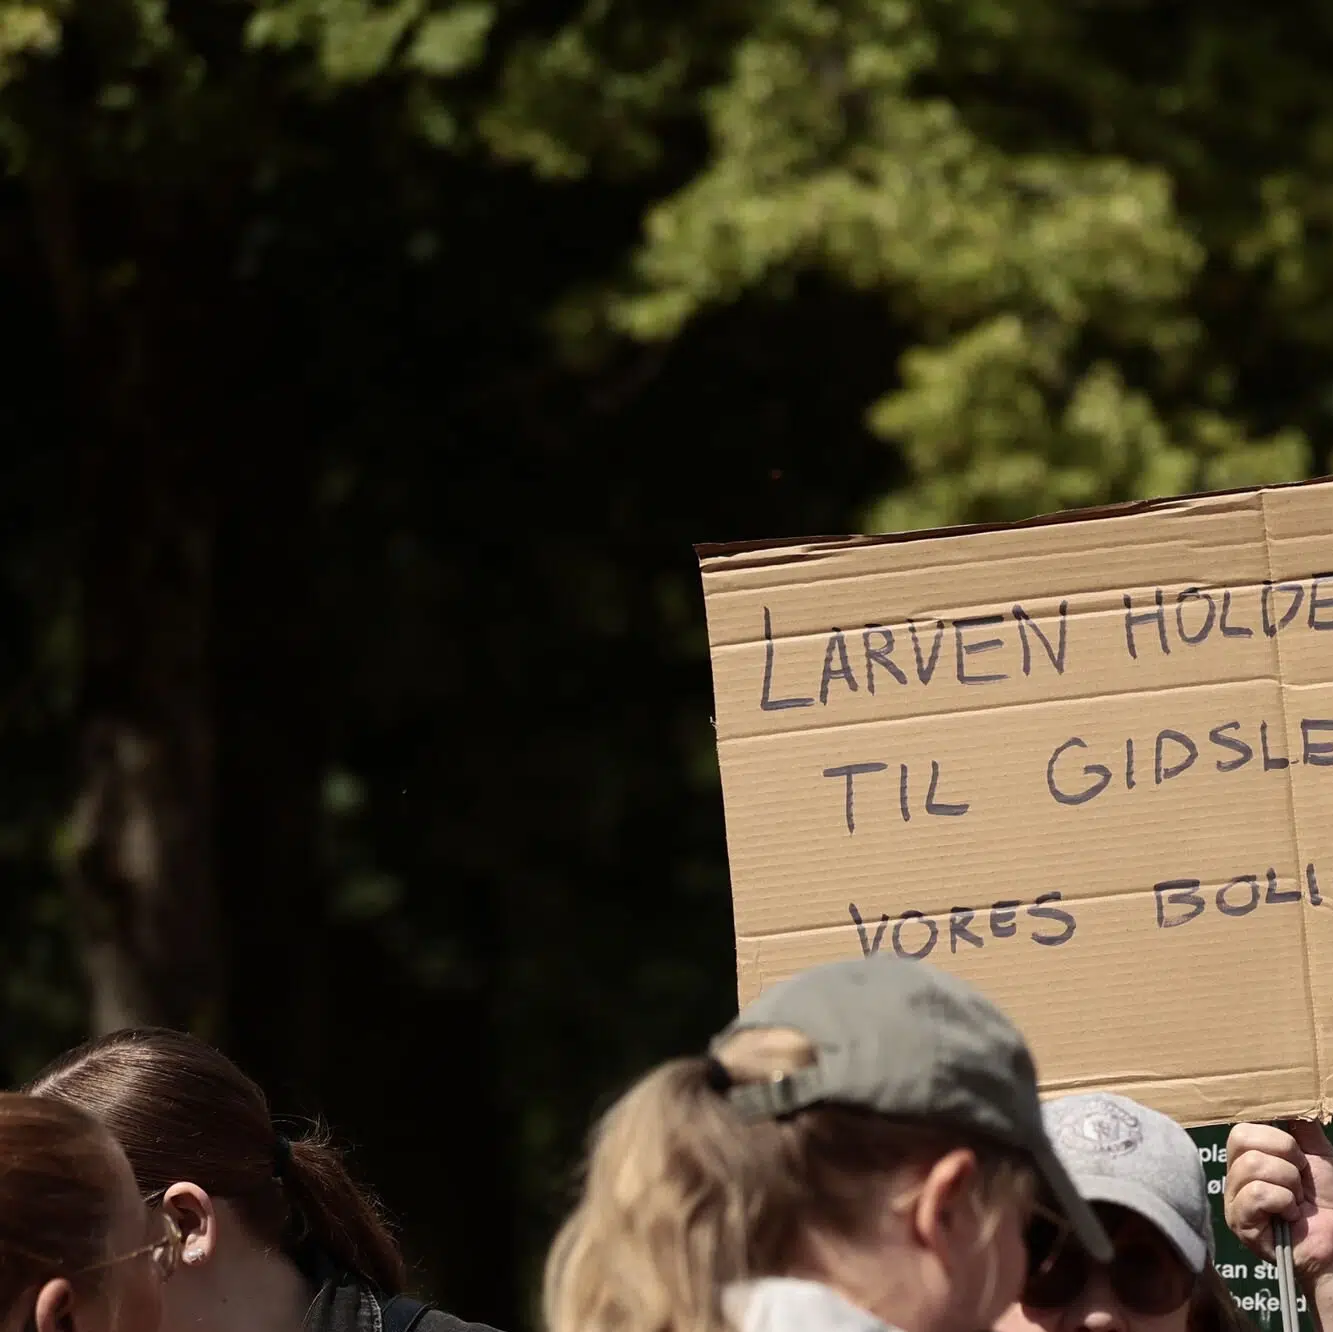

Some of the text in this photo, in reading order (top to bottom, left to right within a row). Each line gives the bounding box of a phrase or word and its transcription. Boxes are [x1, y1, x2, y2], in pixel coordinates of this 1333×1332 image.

[759, 600, 1069, 711] LARVEN
[822, 760, 970, 835] TIL
[848, 890, 1077, 961] VORES
